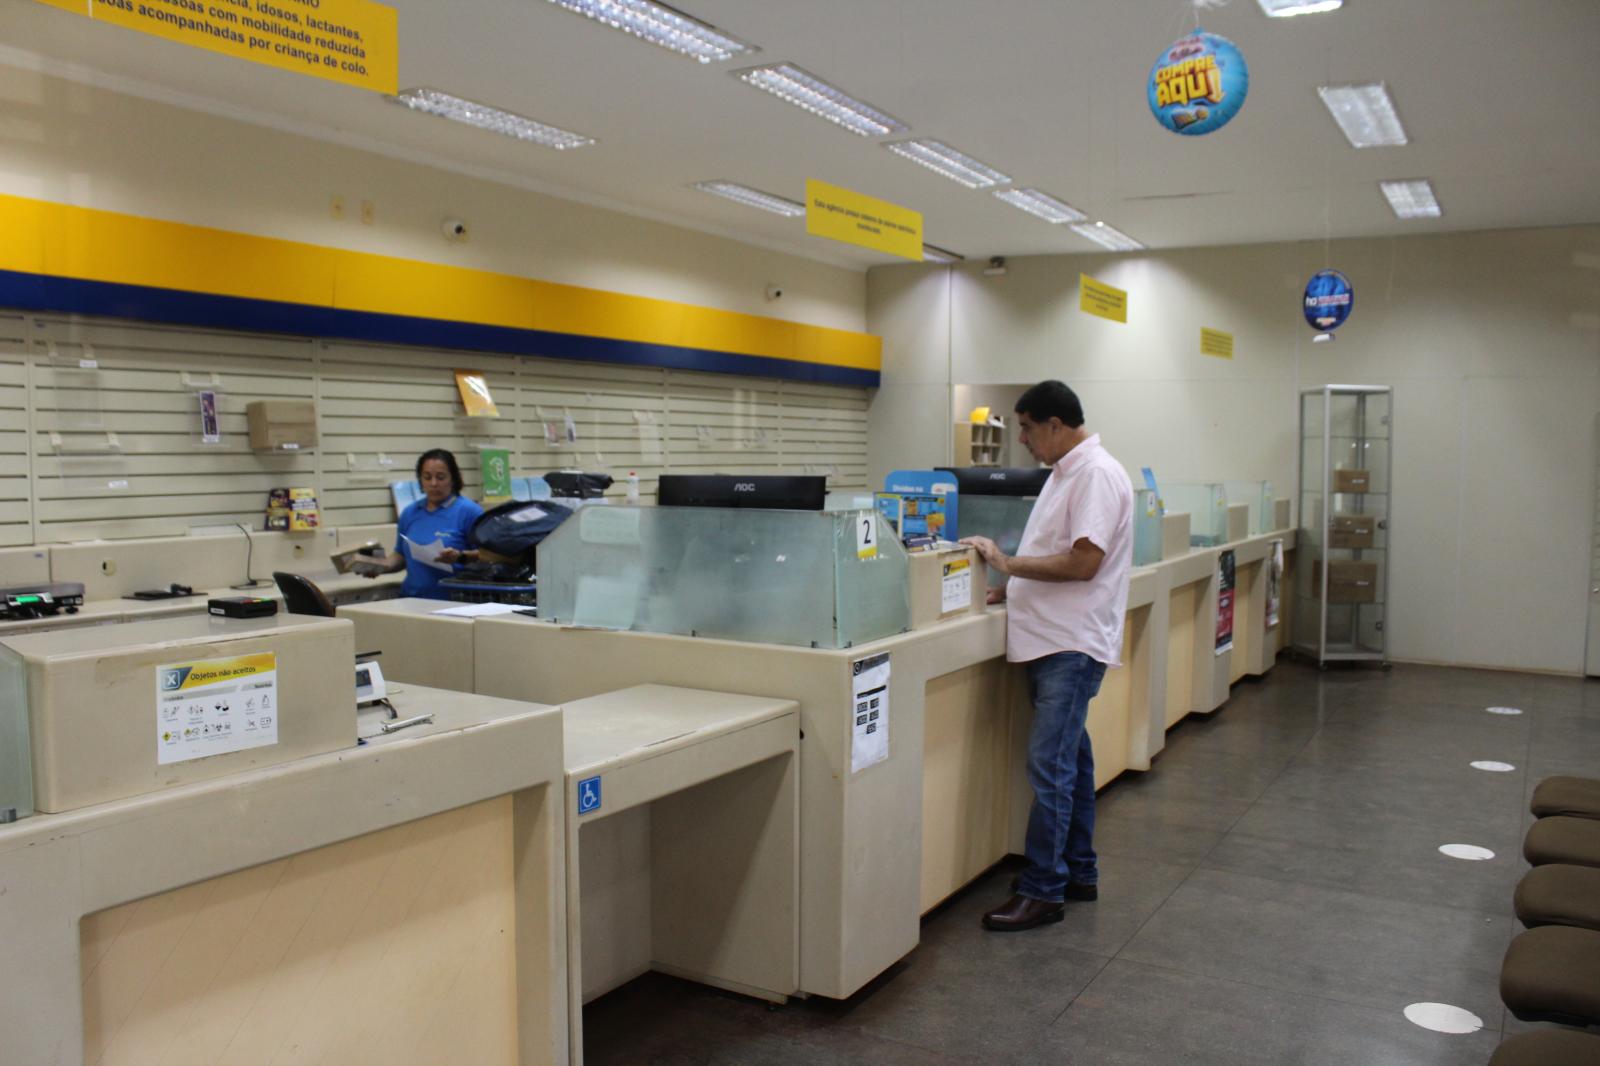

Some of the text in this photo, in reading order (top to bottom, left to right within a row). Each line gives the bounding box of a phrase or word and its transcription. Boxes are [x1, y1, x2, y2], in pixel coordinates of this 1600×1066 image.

[209, 6, 238, 23] com
[242, 16, 311, 43] mobilidade
[315, 35, 366, 58] reduzida
[256, 2, 302, 25] idosos,
[306, 14, 363, 42] lactantes,
[138, 5, 245, 43] acompanhadas
[249, 36, 270, 49] por
[274, 42, 320, 64] criança
[323, 54, 338, 67] de
[341, 60, 369, 76] colo.
[1156, 55, 1217, 84] COMPRE
[734, 482, 756, 491] AOC
[863, 519, 872, 544] 2
[190, 666, 256, 681] Objetos não aceitos
